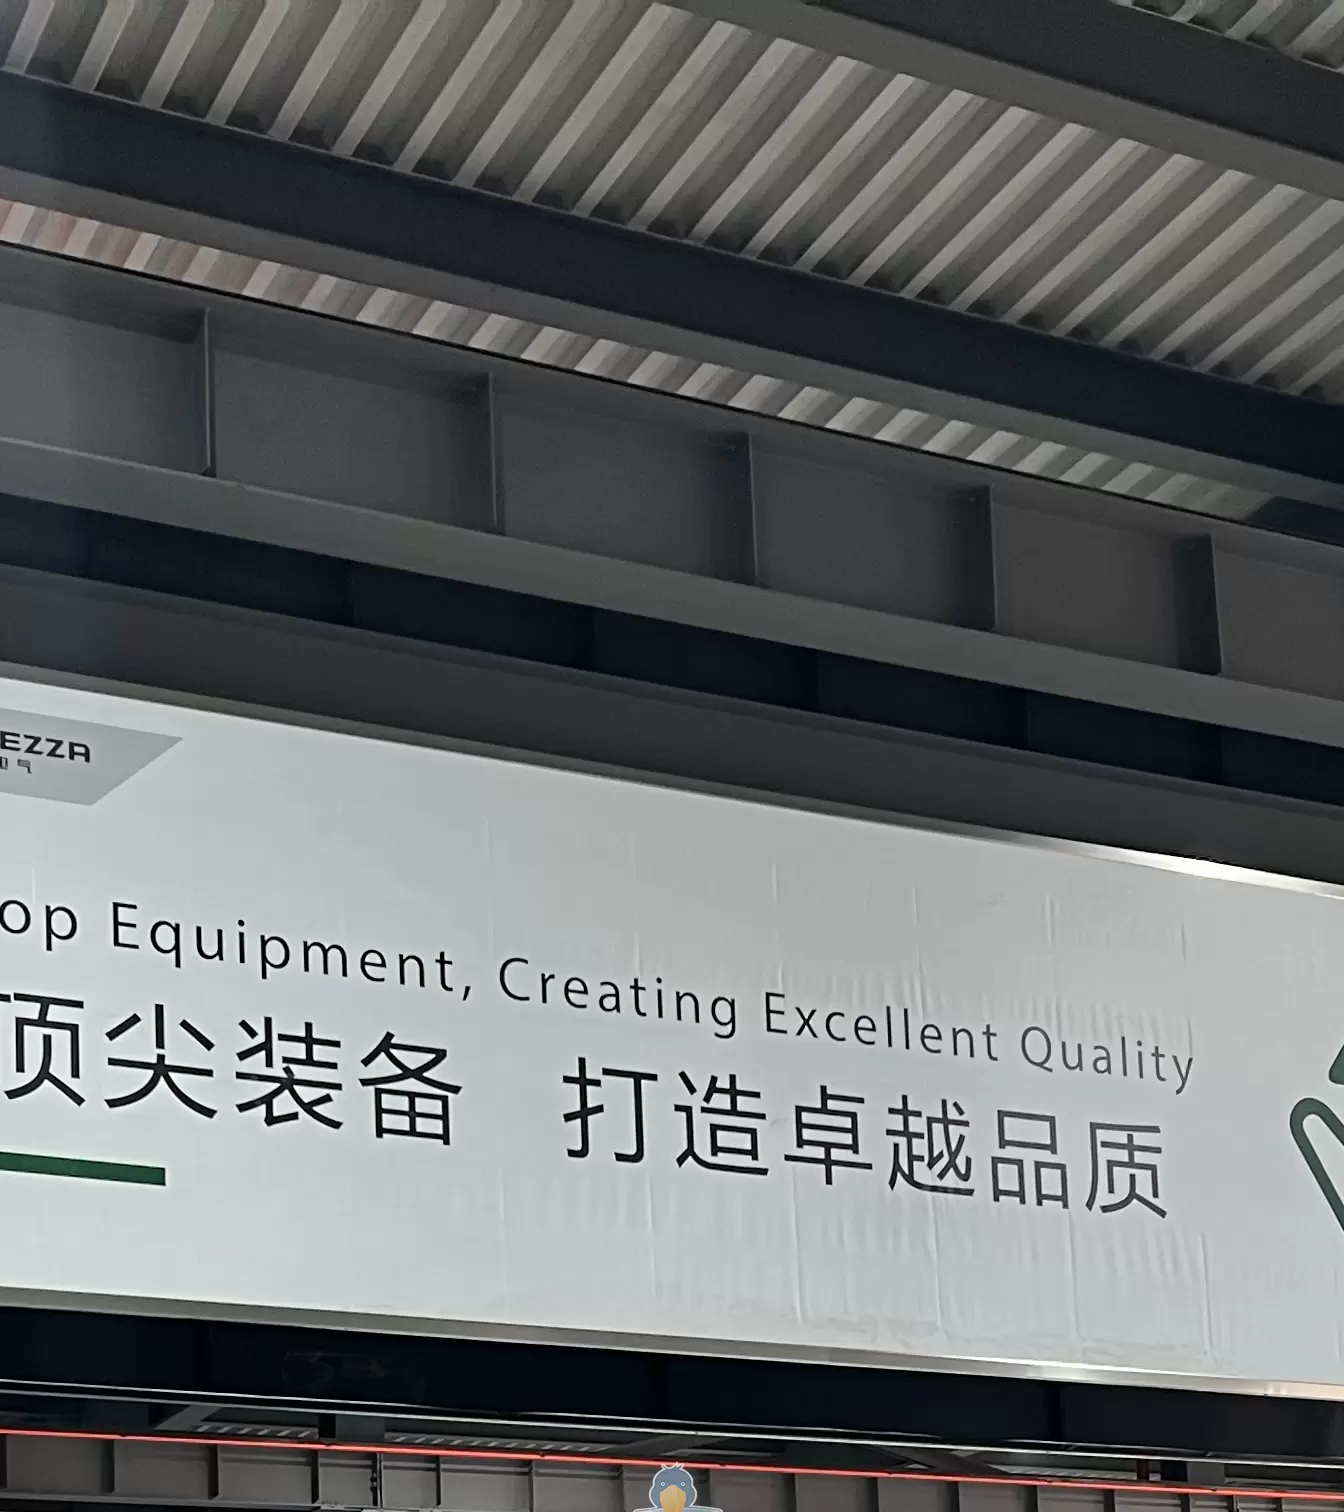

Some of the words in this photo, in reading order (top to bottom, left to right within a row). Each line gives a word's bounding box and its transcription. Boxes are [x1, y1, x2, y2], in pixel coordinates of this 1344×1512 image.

[112, 900, 472, 1001] Equipment,
[498, 956, 738, 1039] Creating
[764, 991, 998, 1062] Excellent
[1020, 1025, 1194, 1095] Quality
[561, 1056, 1168, 1219] 打造卓越品质
